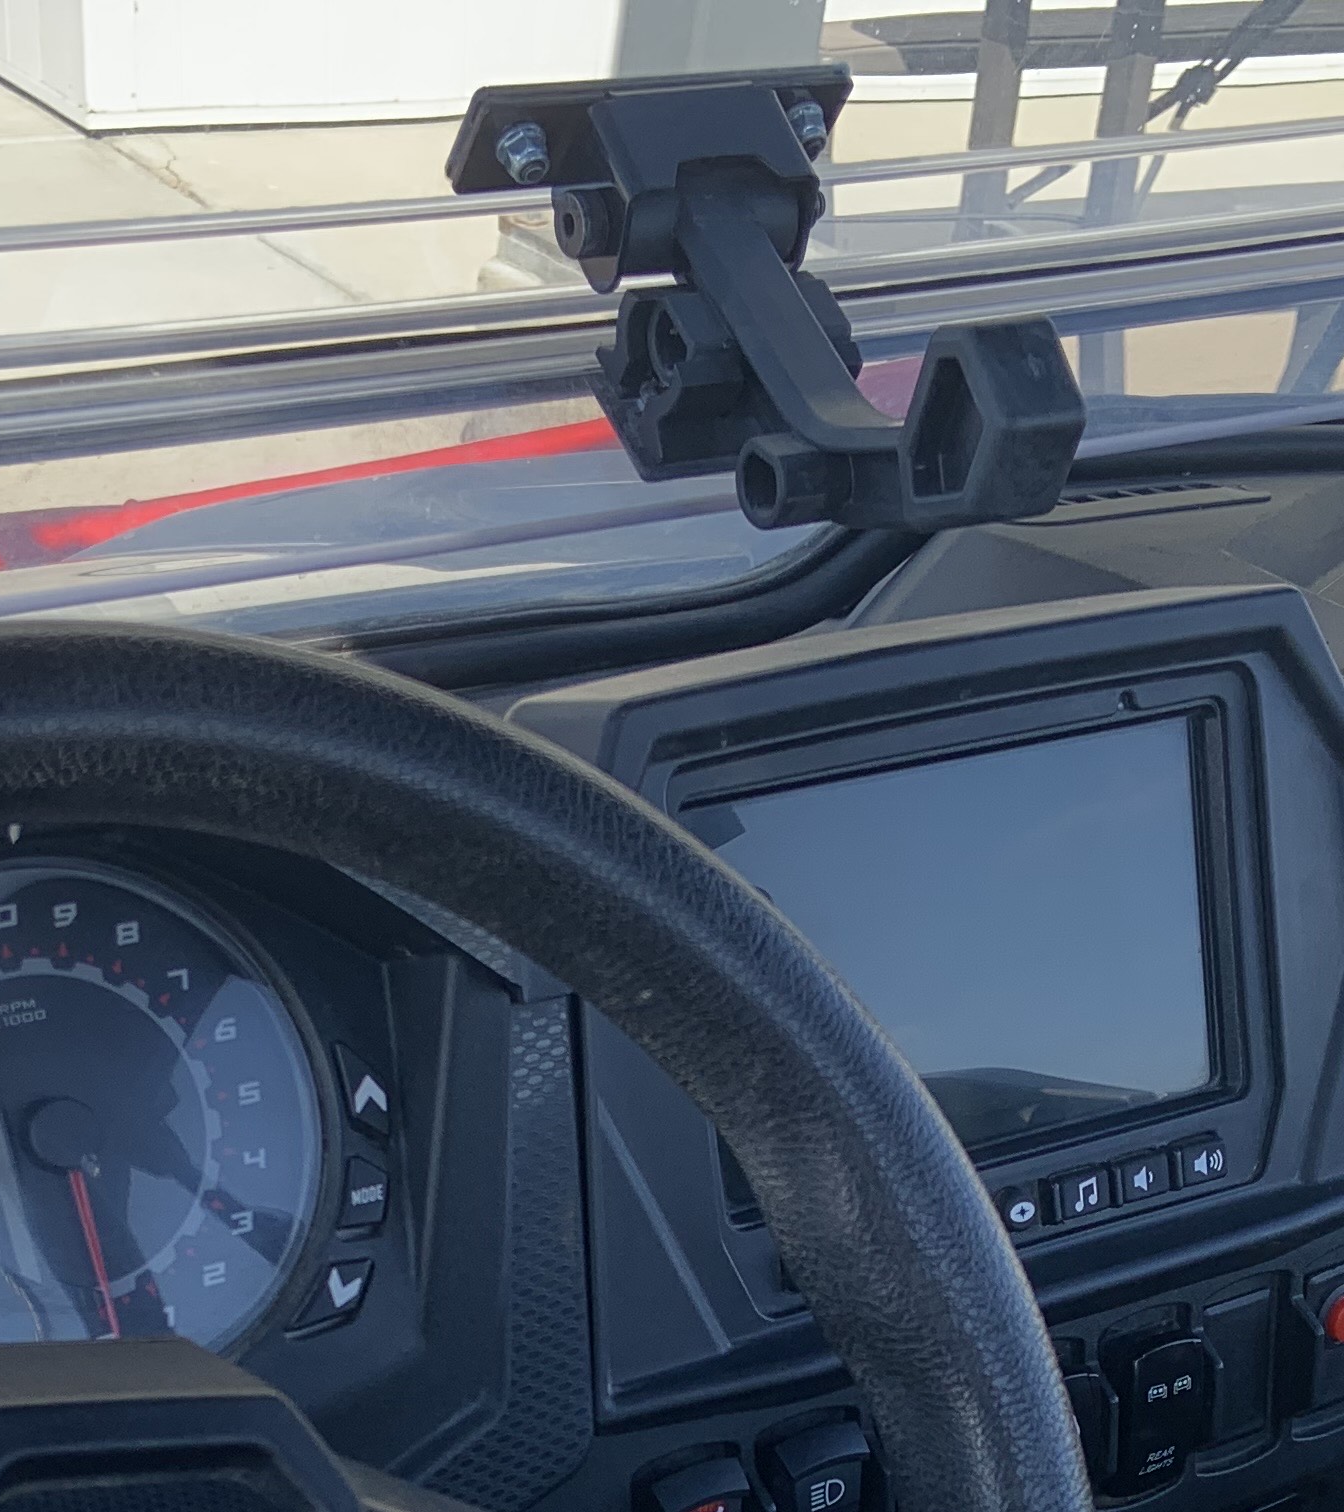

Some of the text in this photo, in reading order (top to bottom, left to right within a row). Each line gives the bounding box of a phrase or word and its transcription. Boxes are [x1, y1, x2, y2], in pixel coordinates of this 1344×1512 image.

[53, 902, 77, 928] 9
[115, 921, 140, 946] 8
[167, 968, 190, 990] 7
[214, 1017, 237, 1042] 6
[238, 1082, 261, 1106] 5
[243, 1148, 267, 1170] 4
[351, 1183, 384, 1206] MODE
[231, 1211, 254, 1236] 3
[202, 1261, 227, 1286] 2
[163, 1305, 176, 1328] 1
[1146, 1445, 1176, 1463] REAR
[1138, 1456, 1175, 1476] LIGHTS
